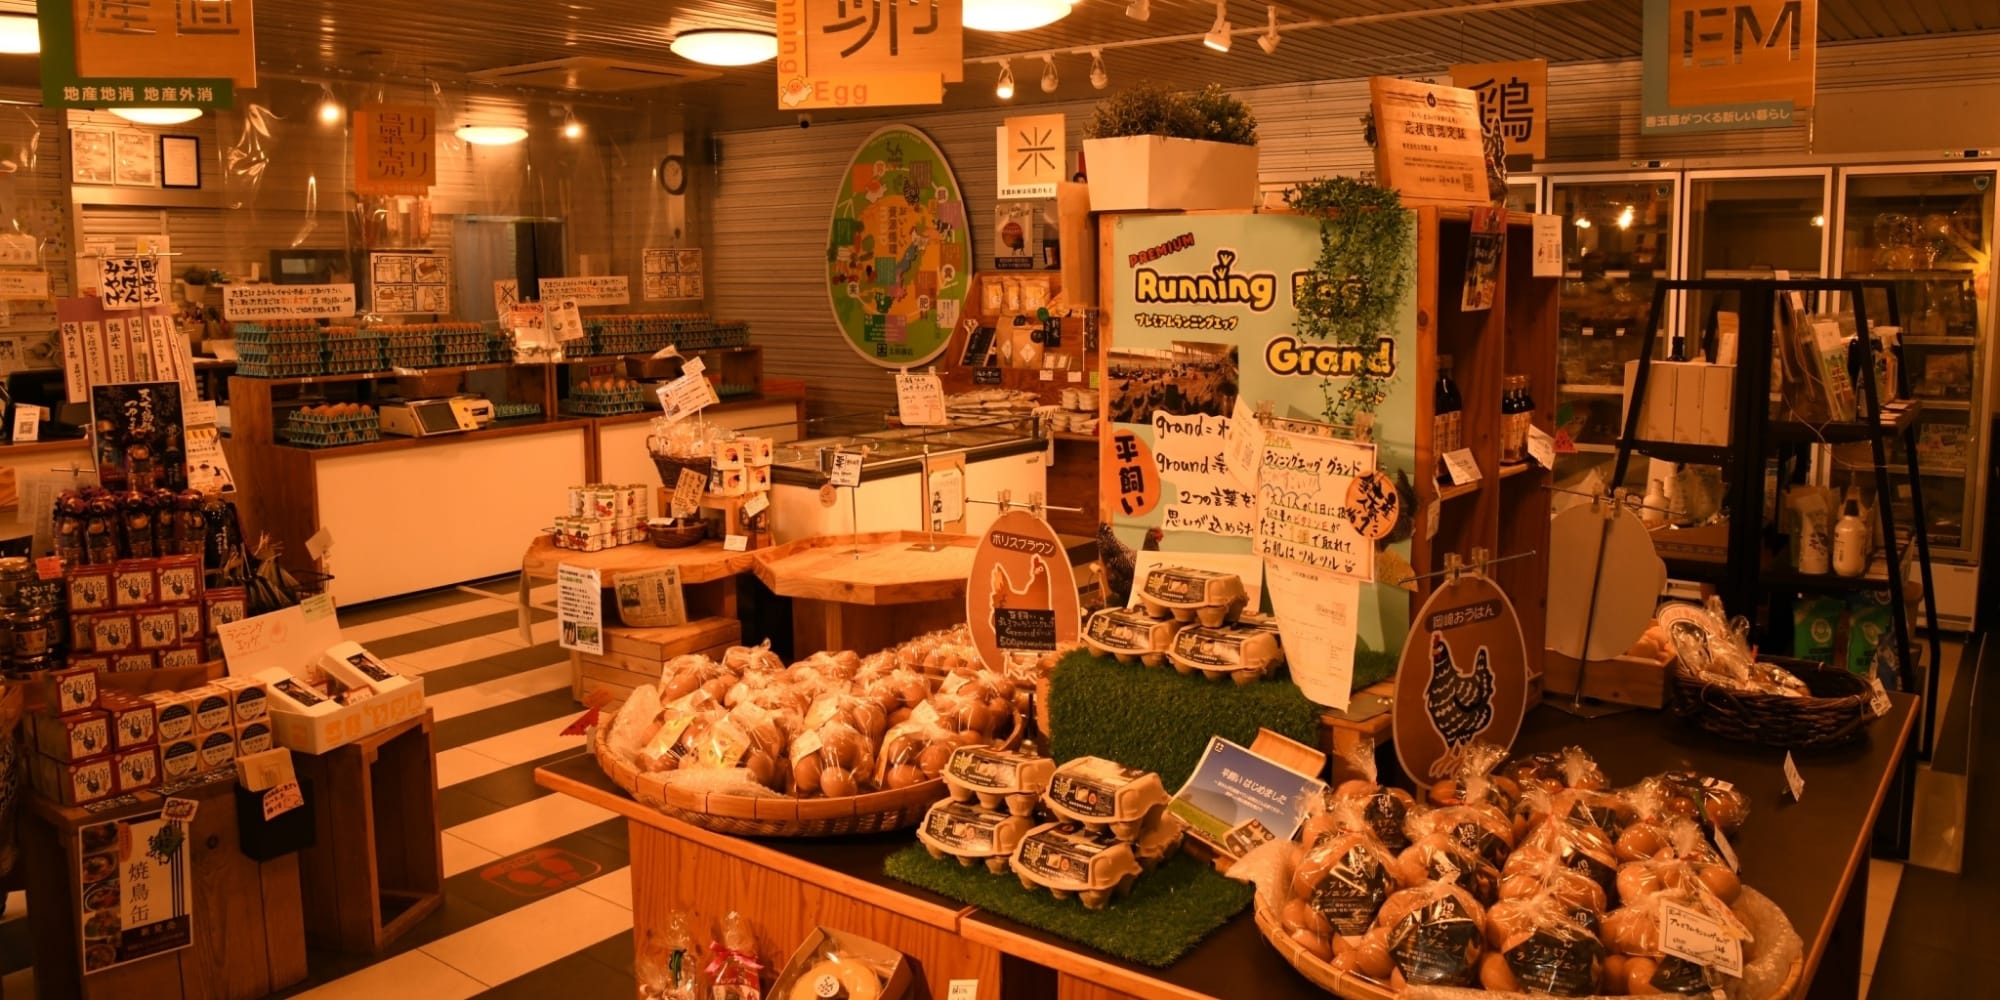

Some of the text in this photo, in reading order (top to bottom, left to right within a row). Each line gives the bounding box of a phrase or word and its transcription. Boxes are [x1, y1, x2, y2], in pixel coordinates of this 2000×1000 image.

[64, 86, 213, 101] 地産地消 地産外消
[814, 81, 868, 105] Egg
[1017, 127, 1056, 177] 米
[1129, 232, 1195, 268] PREMIUM
[1135, 264, 1276, 312] Running
[1266, 337, 1396, 377] Grand
[1114, 434, 1145, 516] 平飼い
[1327, 456, 1362, 478] グランド
[128, 861, 150, 924] 焼鳥缶
